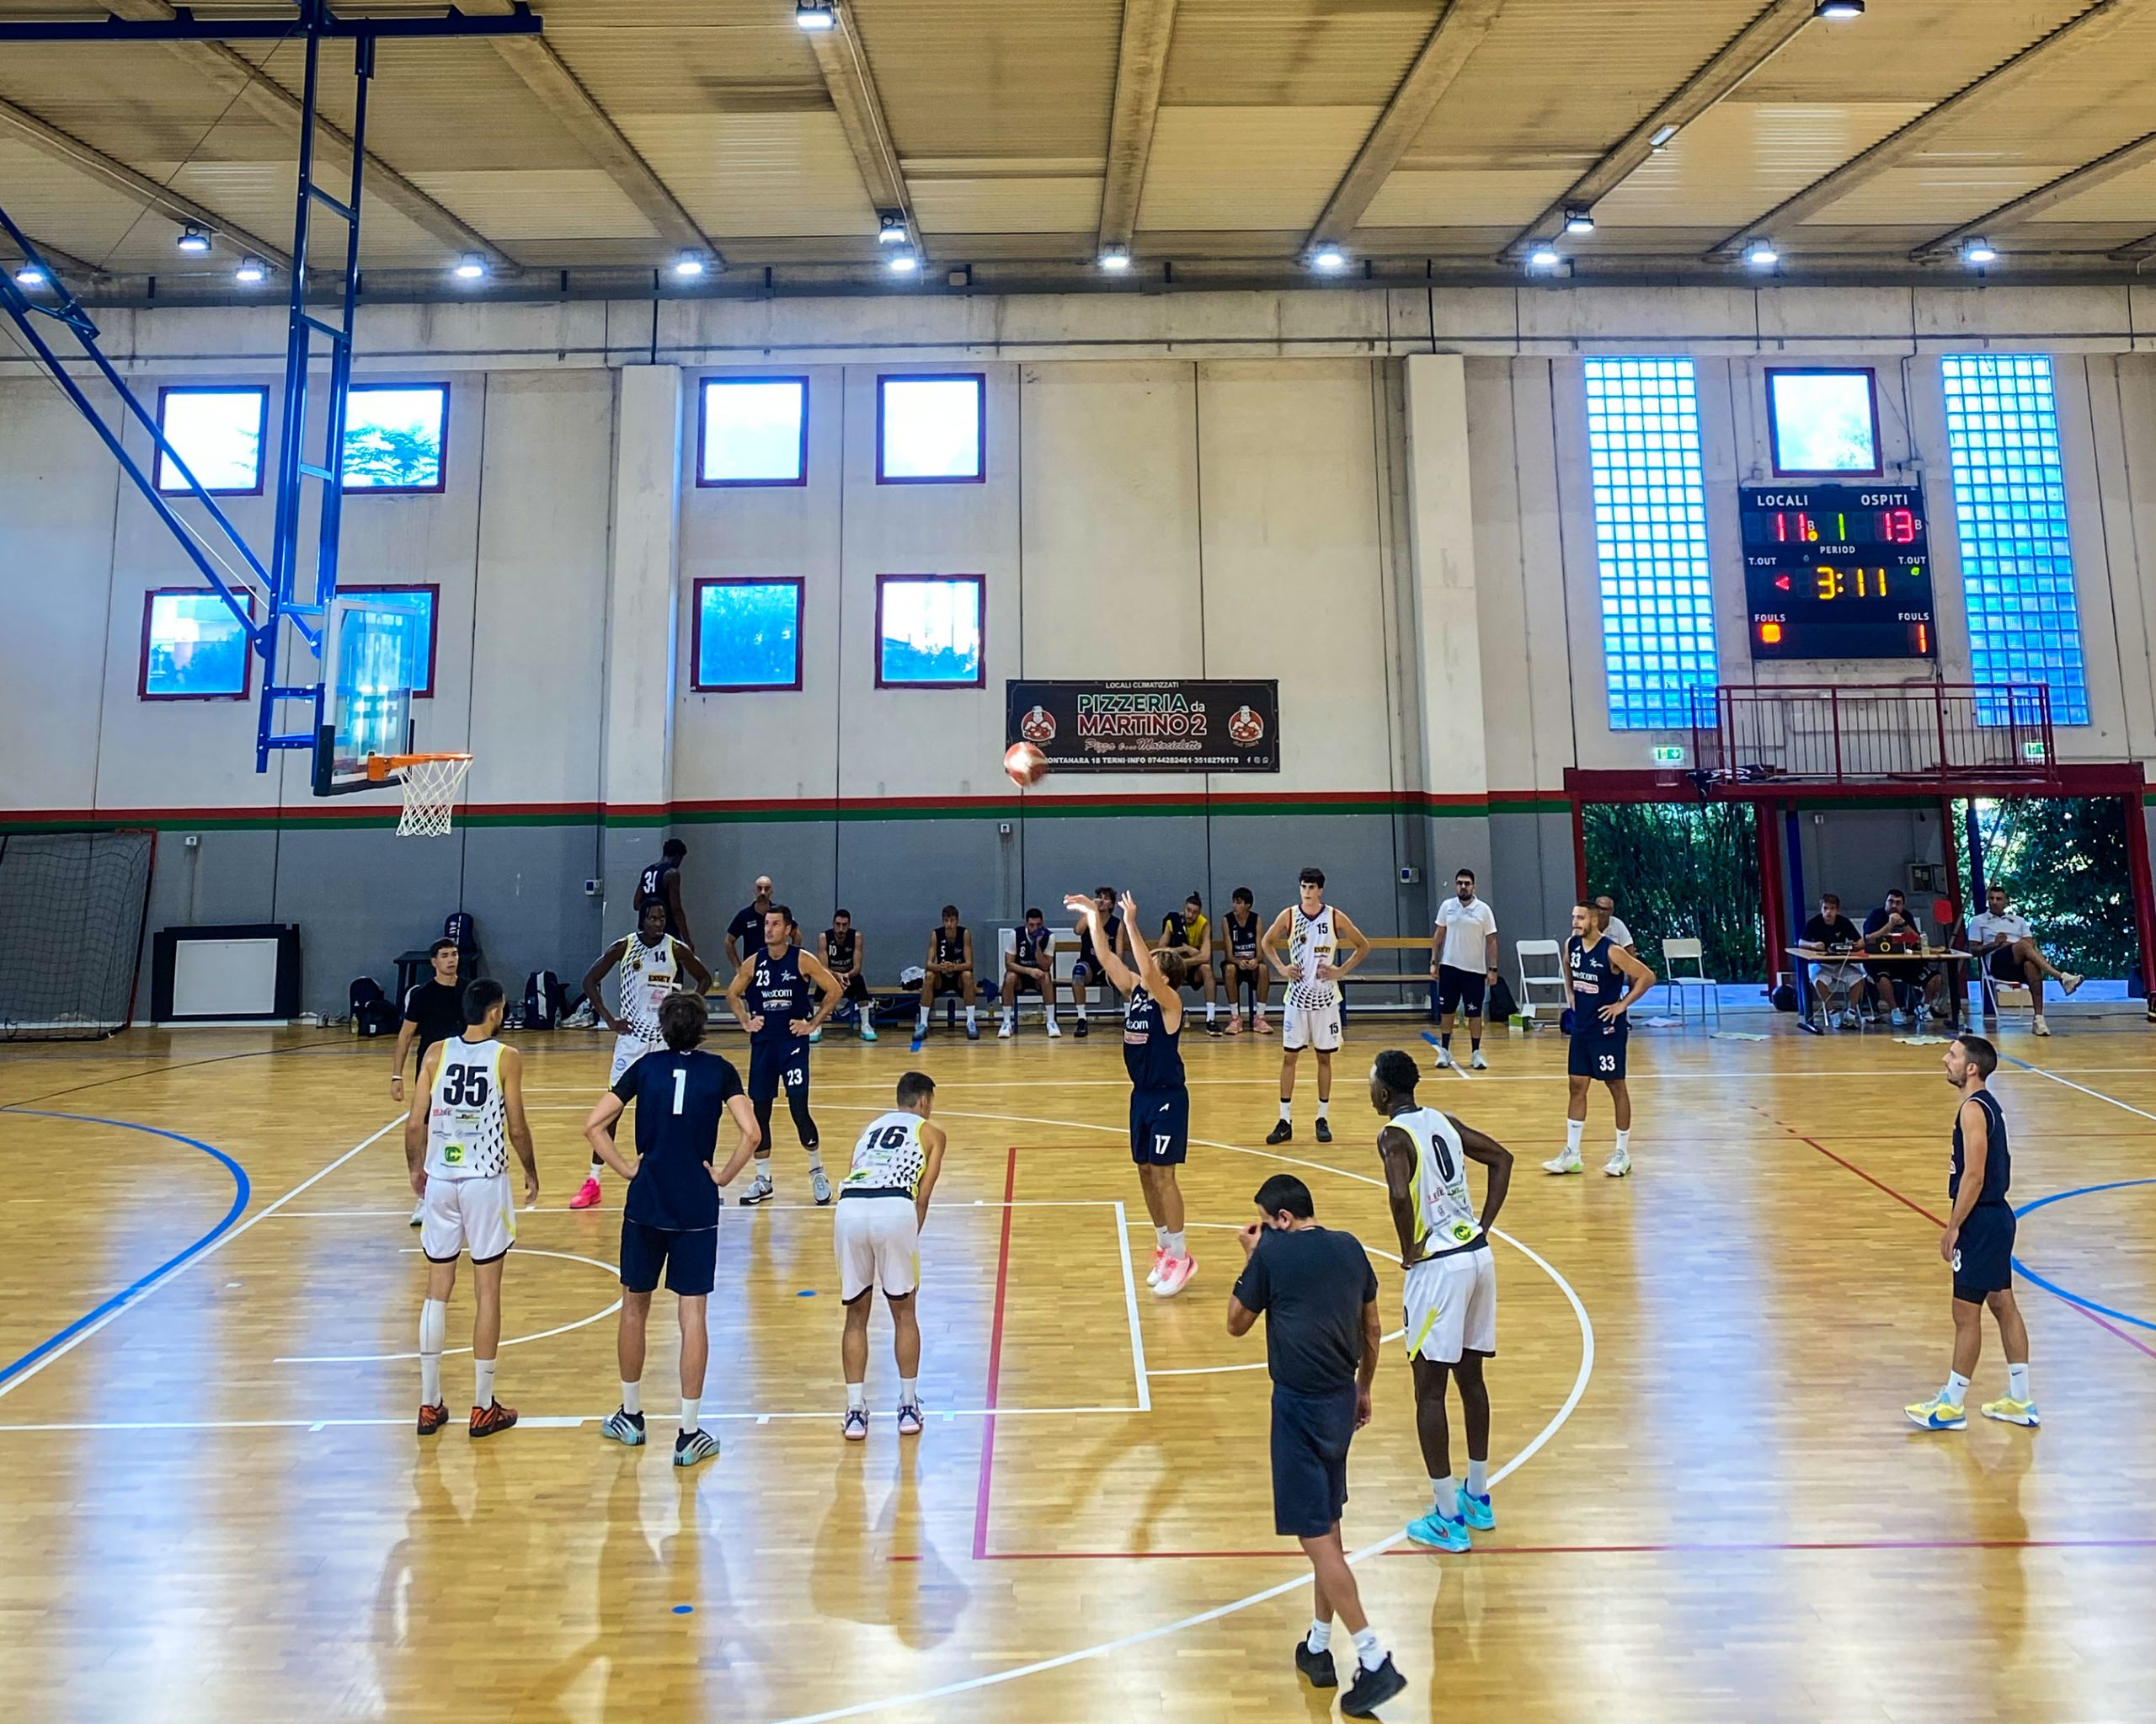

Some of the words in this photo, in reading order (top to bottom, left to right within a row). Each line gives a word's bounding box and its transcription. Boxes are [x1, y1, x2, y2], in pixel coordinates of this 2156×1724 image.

[1757, 495, 1808, 506] LOCALI
[1860, 494, 1908, 505] OSPITI
[1777, 512, 1806, 542] 11
[1838, 512, 1846, 541] 1
[1884, 510, 1914, 543] 13
[1914, 519, 1923, 530] B
[1819, 546, 1855, 554] PERIOD
[1748, 557, 1777, 565] T.OUT
[1897, 556, 1927, 565] T.OUT
[1817, 567, 1886, 600] 3:11
[1754, 613, 1785, 622] FOULS
[1898, 612, 1929, 621] FOULS
[1919, 623, 1927, 654] 1
[1077, 694, 1189, 713] PIZZERIA
[1191, 701, 1205, 713] da
[1077, 714, 1189, 736] MARTINO
[1190, 714, 1207, 736] 2
[1316, 923, 1328, 935] 15
[654, 951, 666, 963] 14
[940, 947, 946, 958] 5
[1019, 946, 1026, 958] 8
[1570, 952, 1581, 968] 33
[755, 969, 770, 986] 23
[1329, 1022, 1339, 1035] 15
[1599, 1054, 1615, 1071] 33
[443, 1063, 488, 1107] 35
[787, 1069, 803, 1086] 23
[673, 1069, 686, 1114] 1
[867, 1125, 908, 1150] 16
[1155, 1134, 1171, 1155] 17
[1432, 1134, 1455, 1183] 0
[1952, 1248, 1961, 1273] 8
